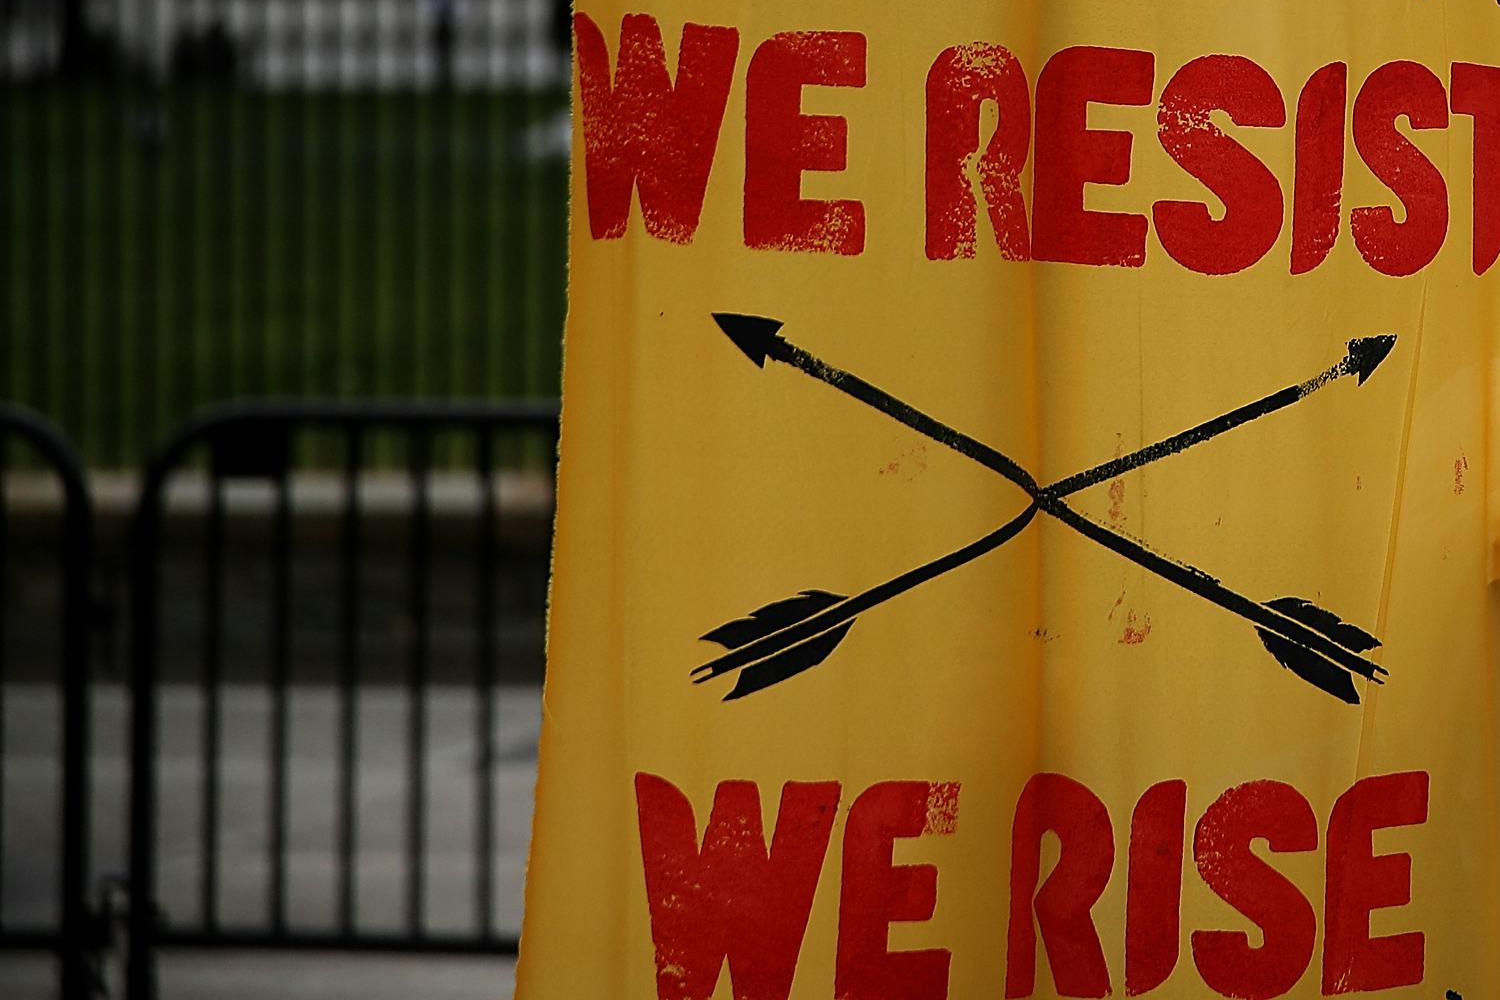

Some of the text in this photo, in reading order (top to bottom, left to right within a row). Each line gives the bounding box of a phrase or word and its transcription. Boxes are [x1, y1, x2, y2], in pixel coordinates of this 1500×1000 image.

[574, 11, 867, 256] WE
[635, 771, 1429, 1000] WE RISE
